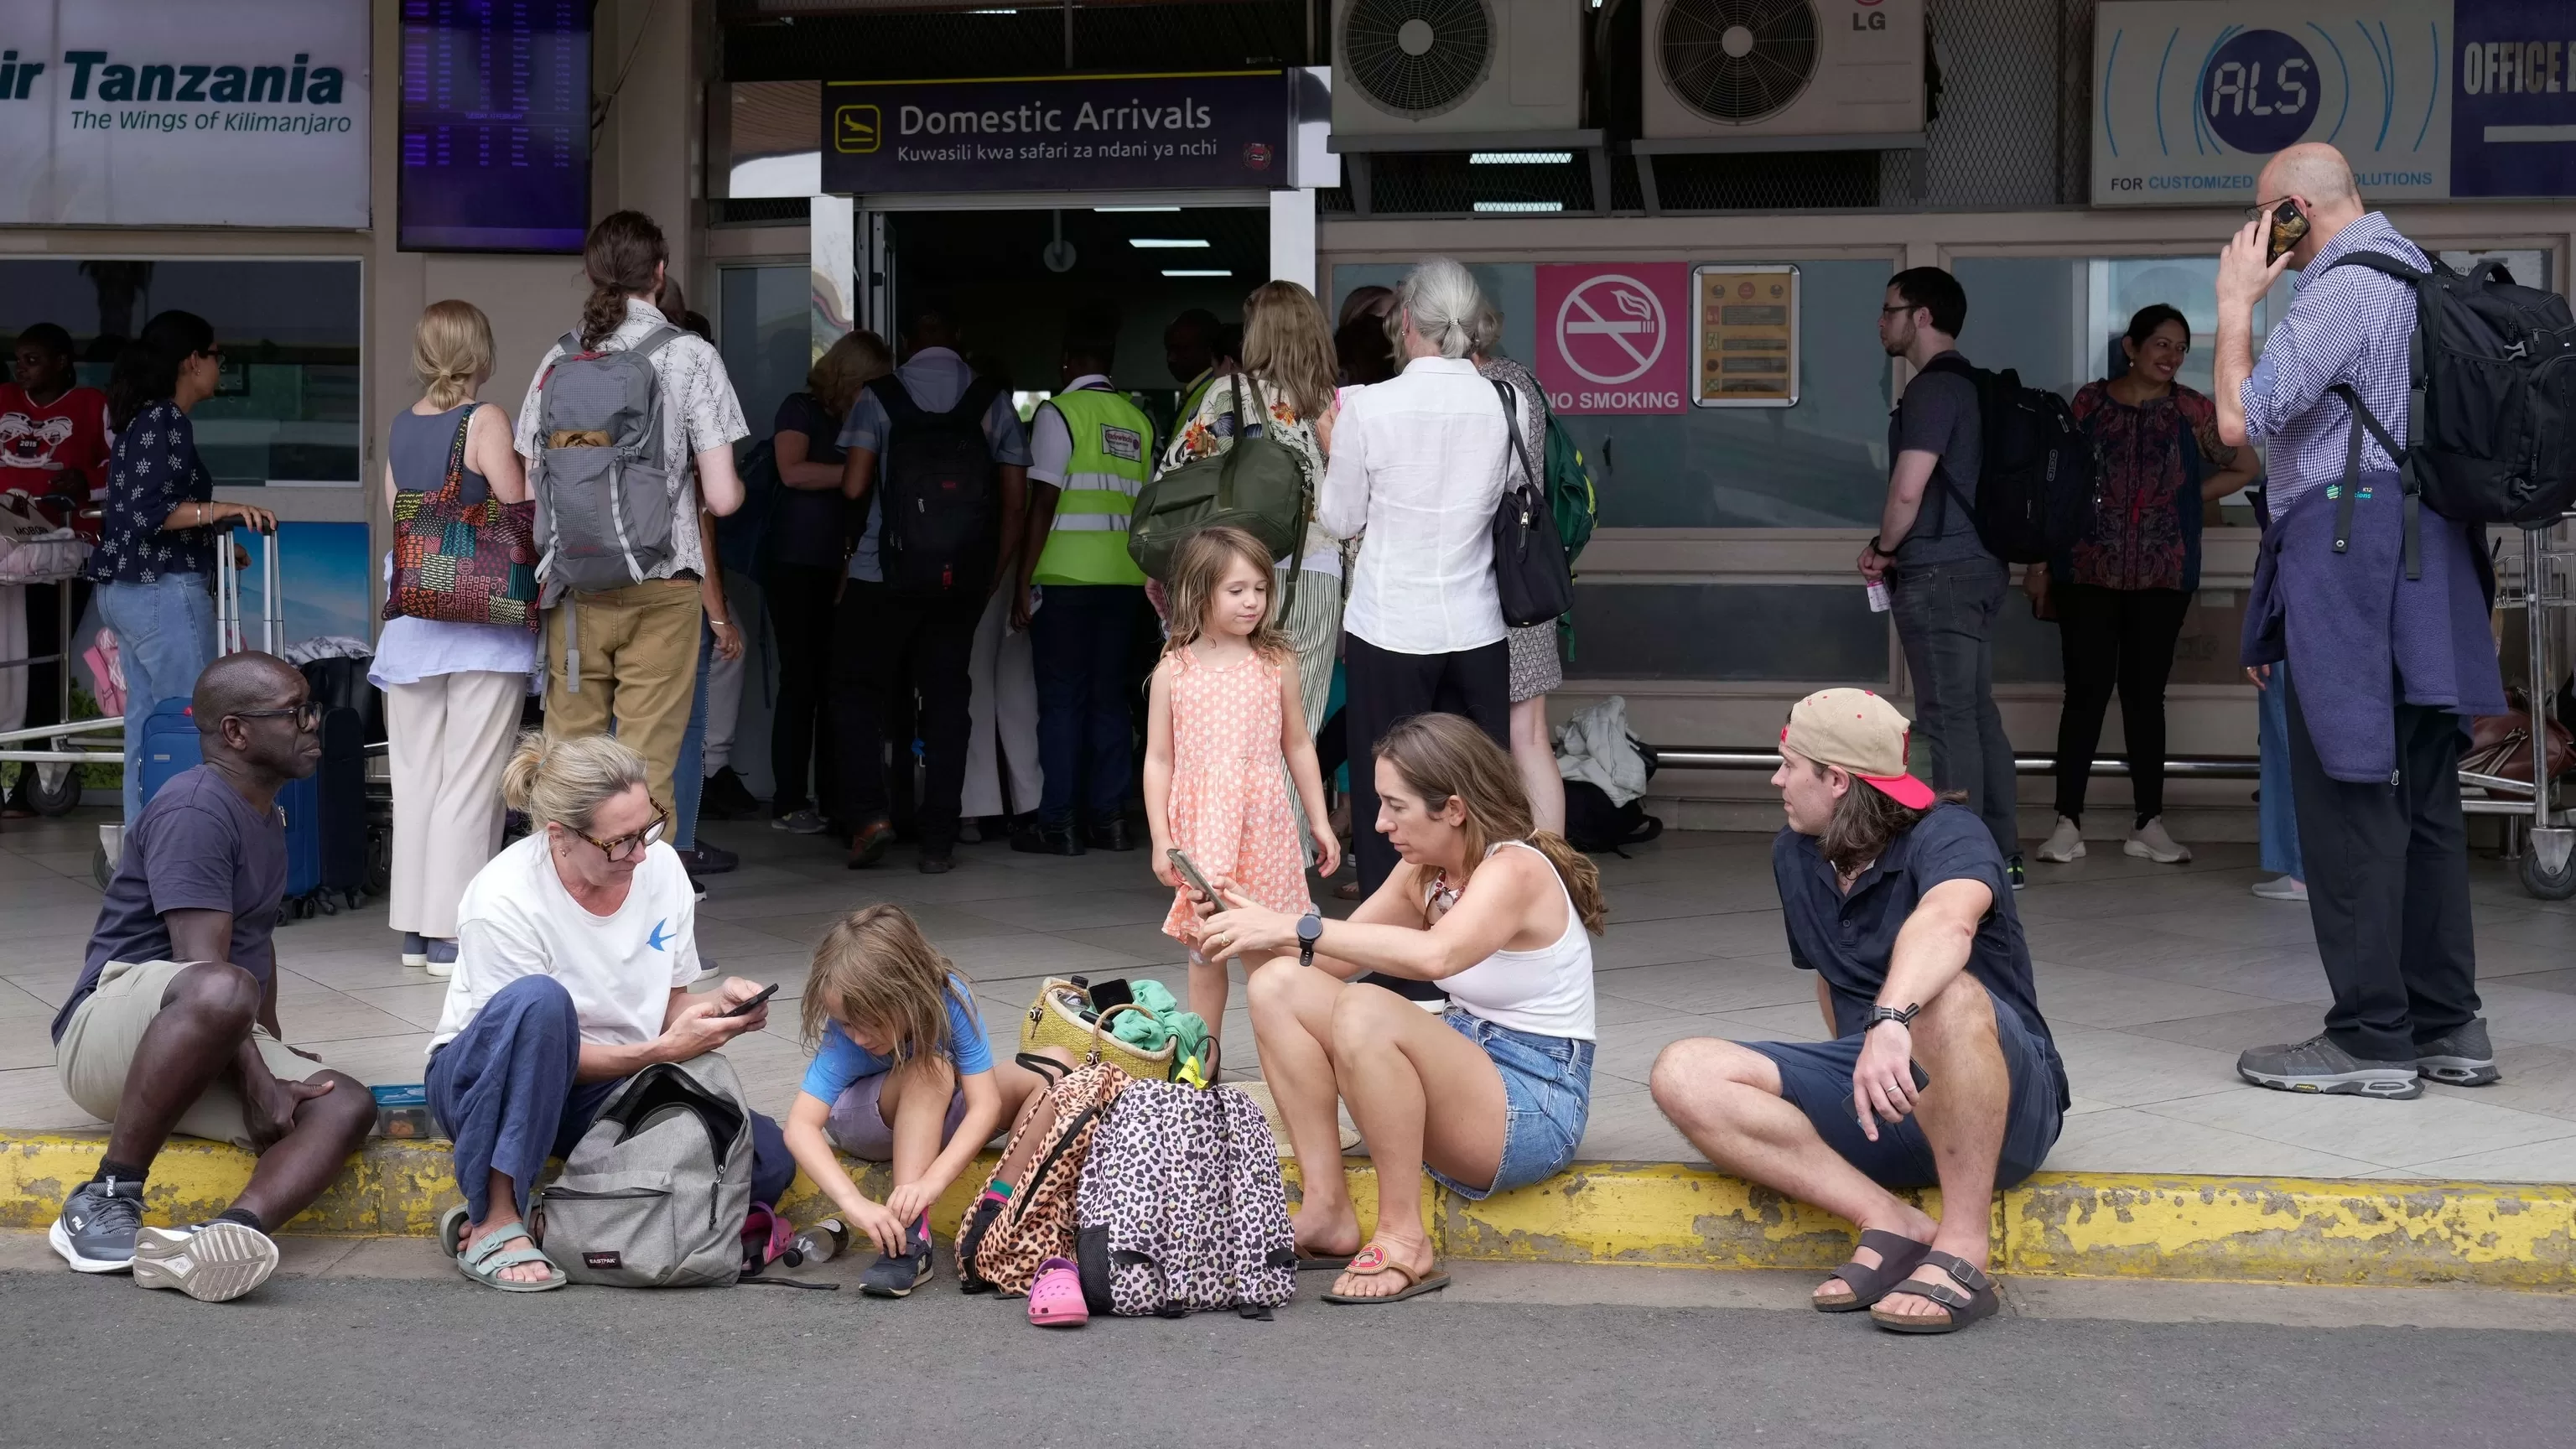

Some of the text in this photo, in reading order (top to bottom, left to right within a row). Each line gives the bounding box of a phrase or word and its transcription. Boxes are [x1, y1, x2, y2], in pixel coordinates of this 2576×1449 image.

[1852, 11, 1886, 31] LG
[0, 50, 44, 101] ir
[64, 50, 344, 105] Tanzania
[2464, 41, 2562, 95] OFFICE
[2210, 58, 2310, 117] ALS
[70, 110, 351, 135] The Wings of Kilimanjaro
[900, 97, 1212, 135] Domestic Arrivals
[898, 138, 1217, 162] Kuwasili kwa safari za ndani ya nchi
[2111, 172, 2433, 191] FOR CUSTOMIZED OLUTIONS
[1546, 392, 1680, 409] NO SMOKING
